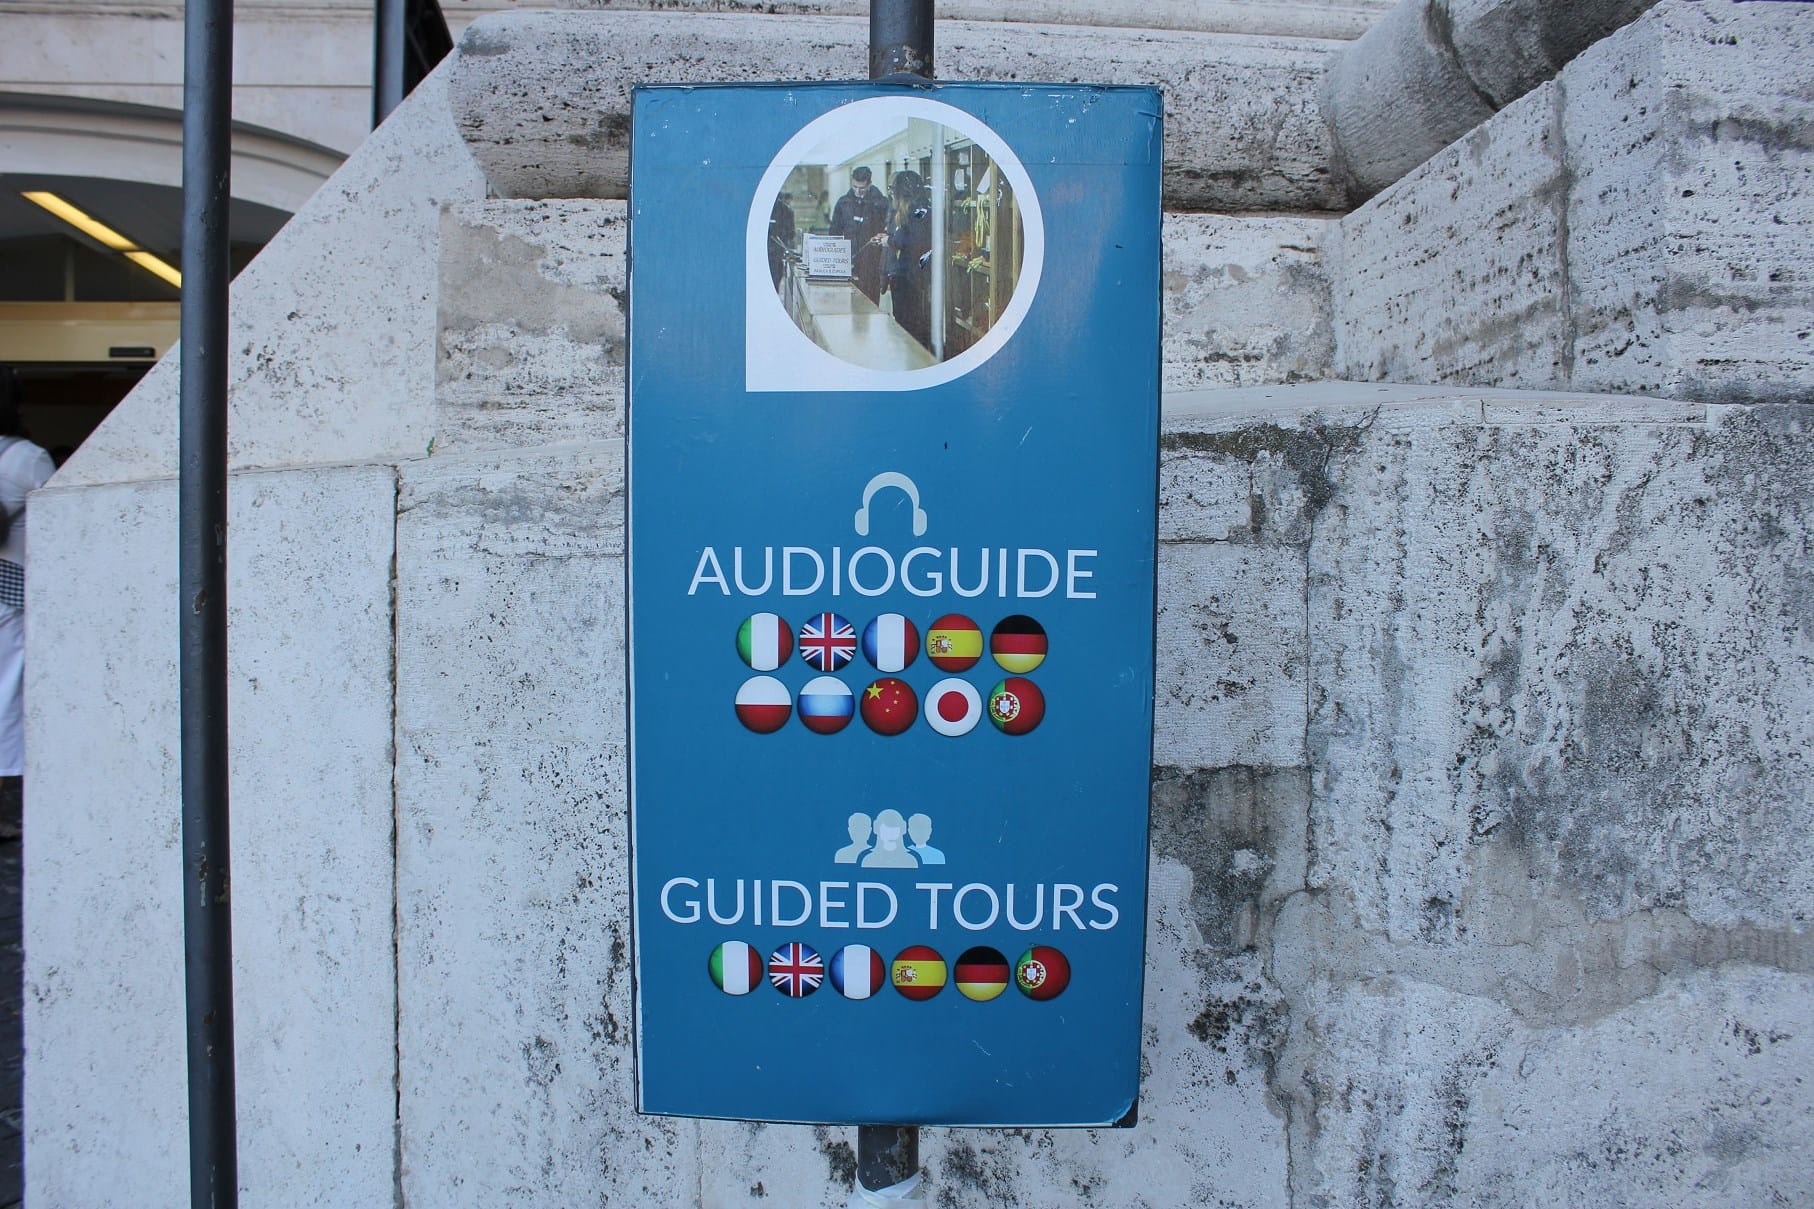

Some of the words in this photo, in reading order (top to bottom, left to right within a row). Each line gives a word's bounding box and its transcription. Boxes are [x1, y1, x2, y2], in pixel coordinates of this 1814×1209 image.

[687, 546, 1098, 599] AUDIOGUIDE
[660, 877, 898, 929] GUIDED
[915, 882, 1119, 930] TOURS
